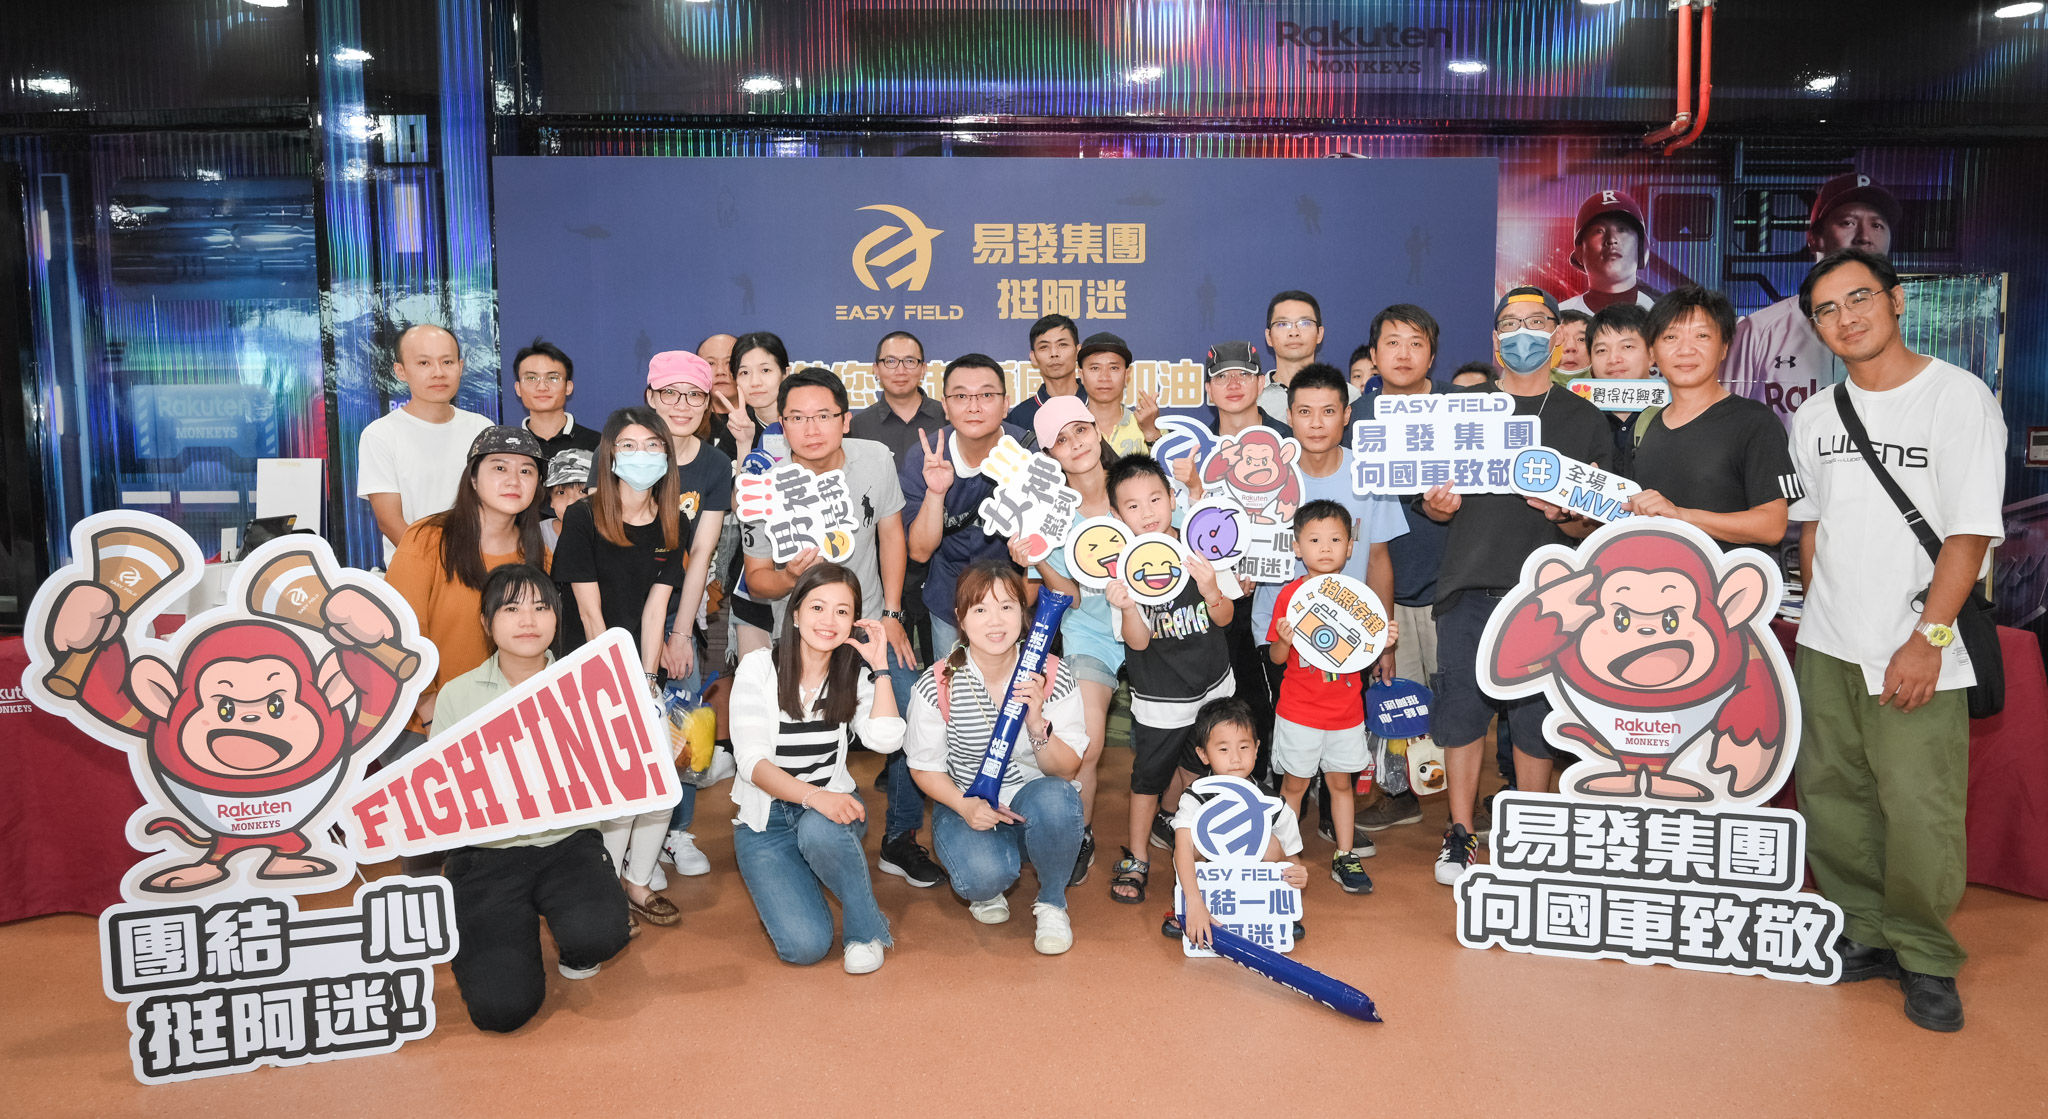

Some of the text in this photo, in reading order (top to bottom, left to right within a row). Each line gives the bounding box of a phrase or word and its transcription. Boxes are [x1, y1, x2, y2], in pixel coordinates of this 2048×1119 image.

[1275, 20, 1453, 49] Rakuten
[1306, 60, 1421, 74] MONKEYS
[972, 222, 1146, 264] 易發集團
[835, 305, 964, 320] EASY FIELD
[997, 278, 1127, 320] 挺阿迷
[158, 395, 254, 418] Rakuten
[1380, 398, 1508, 414] EASY FIELD
[175, 427, 238, 439] MONKEYS
[1357, 421, 1534, 453] 易發集團
[1356, 459, 1511, 488] 向國軍致敬
[1565, 464, 1608, 491] 全場
[1568, 485, 1633, 522] MVP
[743, 523, 755, 548] 3
[1233, 556, 1291, 578] 阿迷!
[1318, 576, 1386, 638] 拍照存證
[1614, 718, 1681, 734] Rakuten
[351, 642, 668, 850] FIGHTING!
[1625, 737, 1670, 747] MONKEYS
[217, 800, 292, 818] Rakuten
[231, 820, 281, 832] MONKEYS
[1503, 803, 1790, 884] 易發集團
[1195, 868, 1287, 881] ASY FIEL
[118, 890, 443, 978] 團結一心
[1467, 877, 1830, 971] 向國軍致敬
[144, 973, 426, 1069] 挺阿迷!
